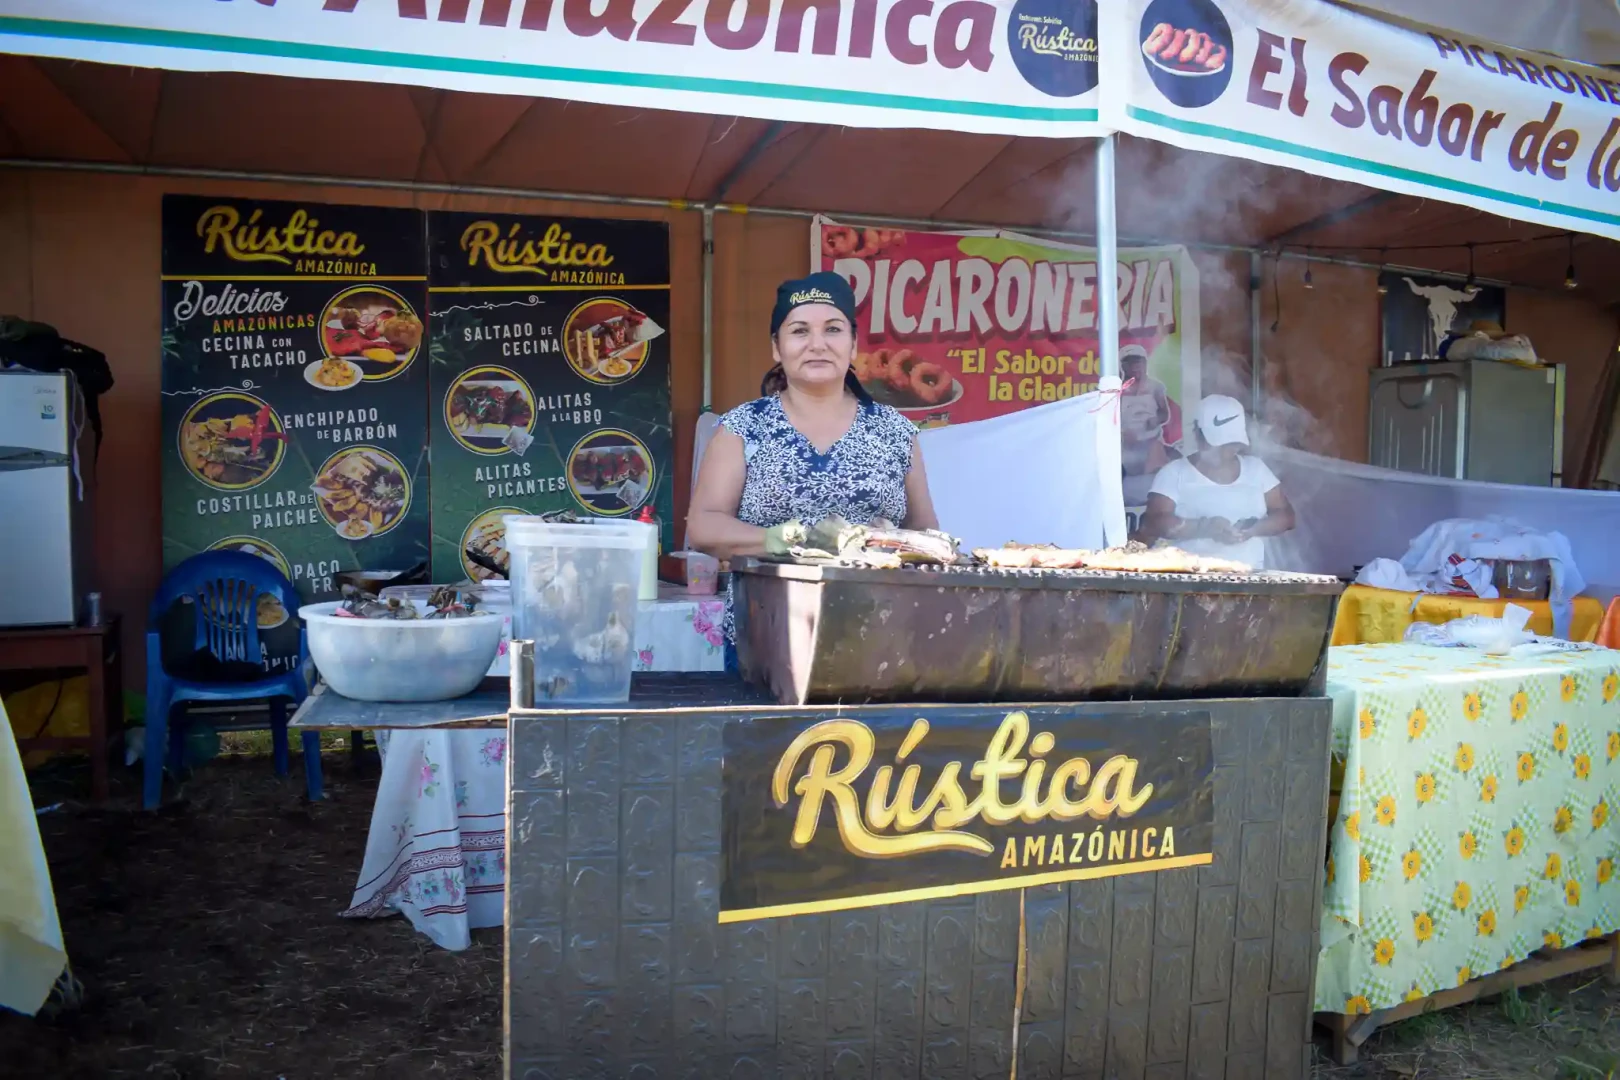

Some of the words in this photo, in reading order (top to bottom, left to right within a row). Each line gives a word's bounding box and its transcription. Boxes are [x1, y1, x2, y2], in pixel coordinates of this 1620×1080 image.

[1018, 23, 1097, 57] Rústica
[1246, 27, 1309, 117] El
[1328, 52, 1506, 163] Sabor
[1508, 101, 1580, 181] de
[197, 205, 365, 265] Rústica
[460, 220, 614, 276] Rústica
[295, 260, 377, 275] AMAZÓNICA
[550, 269, 626, 285] AMAZÓNICA
[174, 281, 289, 322] Delicias
[790, 288, 832, 305] Rústica
[213, 313, 315, 334] AMAZÓNICAS
[464, 323, 533, 342] SALTADO
[541, 326, 553, 336] DE
[202, 334, 265, 353] CECINA
[272, 338, 292, 349] CON
[502, 338, 561, 357] CECINA
[230, 350, 307, 369] TACACHO
[994, 349, 1073, 375] Sabor
[989, 375, 1013, 401] la
[538, 392, 592, 411] ALITAS
[284, 407, 379, 429] ENCHIPADO
[551, 413, 557, 422] A
[560, 412, 571, 422] LA
[573, 409, 602, 425] BBQ
[317, 430, 329, 440] DE
[333, 423, 397, 443] BARBÓN
[475, 462, 532, 482] ALITAS
[487, 477, 567, 499] PICANTES
[197, 490, 298, 515] COSTILLAR
[300, 494, 314, 505] DE
[253, 508, 319, 529] PAICHE
[294, 559, 340, 580] PACO
[772, 710, 1154, 859] Rústica
[1000, 824, 1176, 870] AMAZÓNICA
